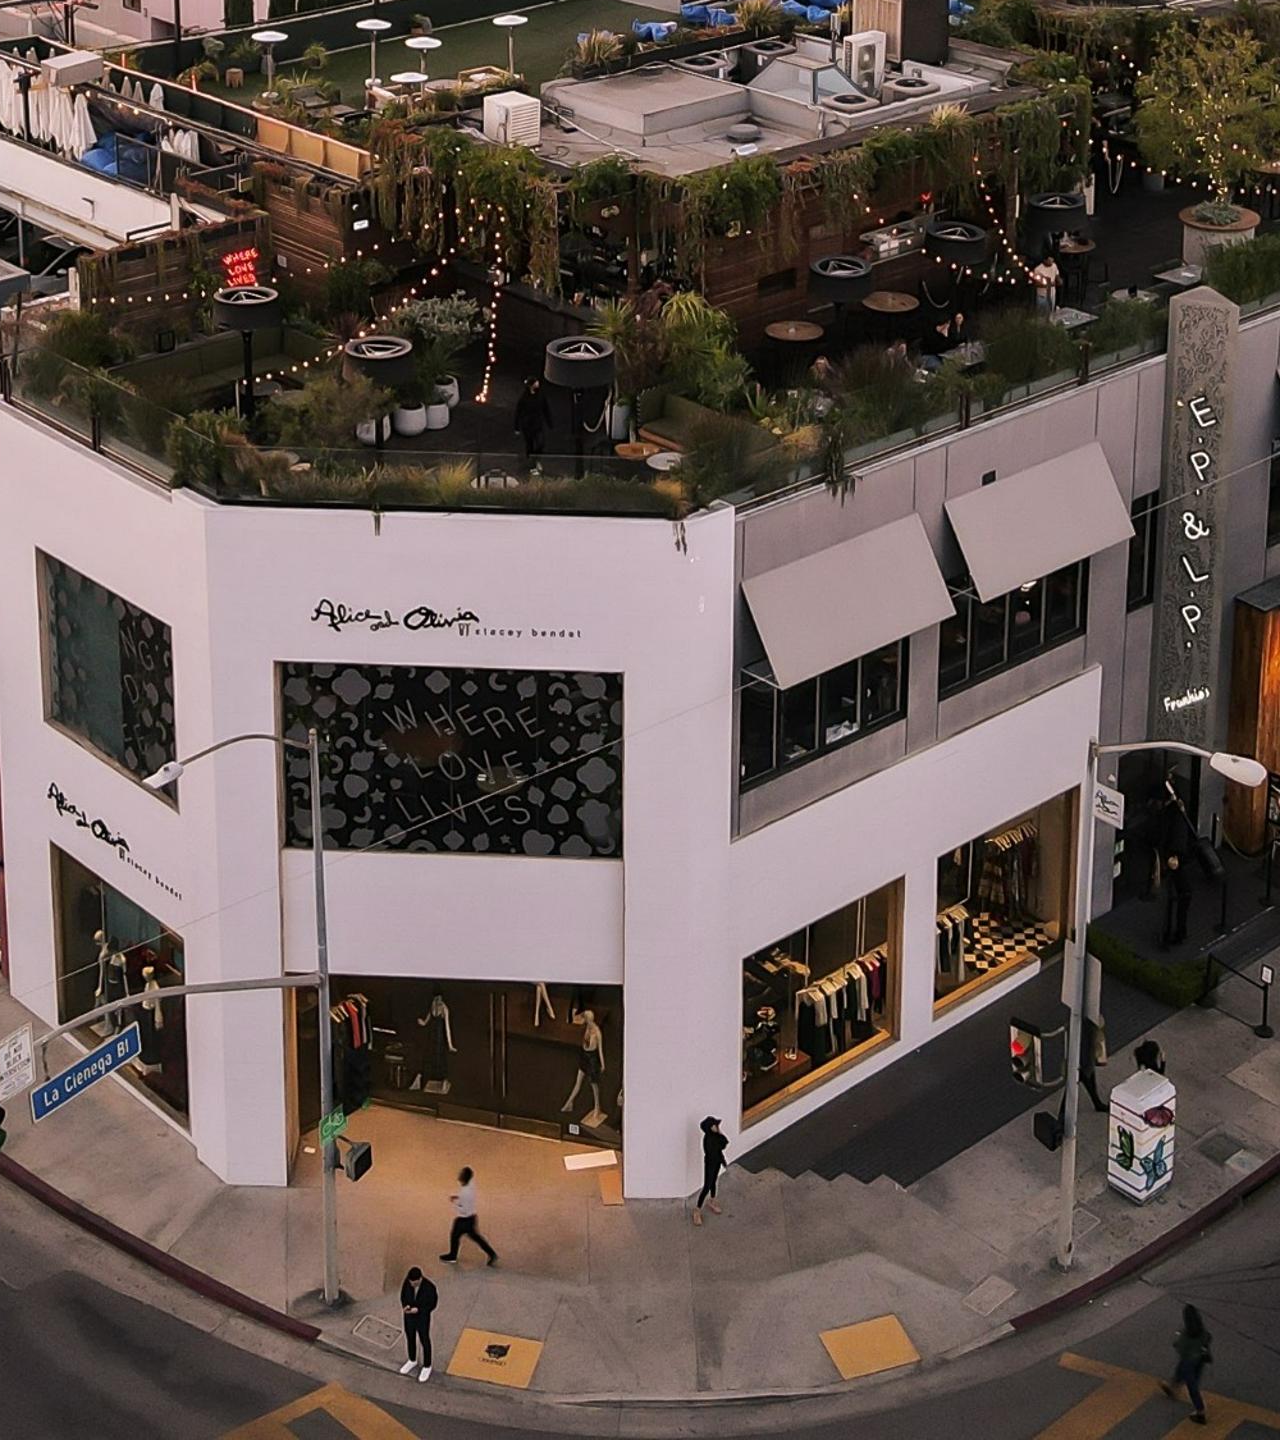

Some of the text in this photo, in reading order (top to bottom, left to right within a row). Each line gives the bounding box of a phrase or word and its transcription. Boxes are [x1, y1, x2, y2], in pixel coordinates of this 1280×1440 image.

[223, 247, 258, 265] WHERE
[228, 261, 255, 276] LOVE
[227, 273, 256, 287] LIVES
[1163, 688, 1211, 713] Frankie's
[382, 698, 546, 739] WHERE
[406, 750, 528, 784] LOVE
[395, 793, 531, 826] LIVES
[43, 1038, 130, 1107] La Cienega Bl
